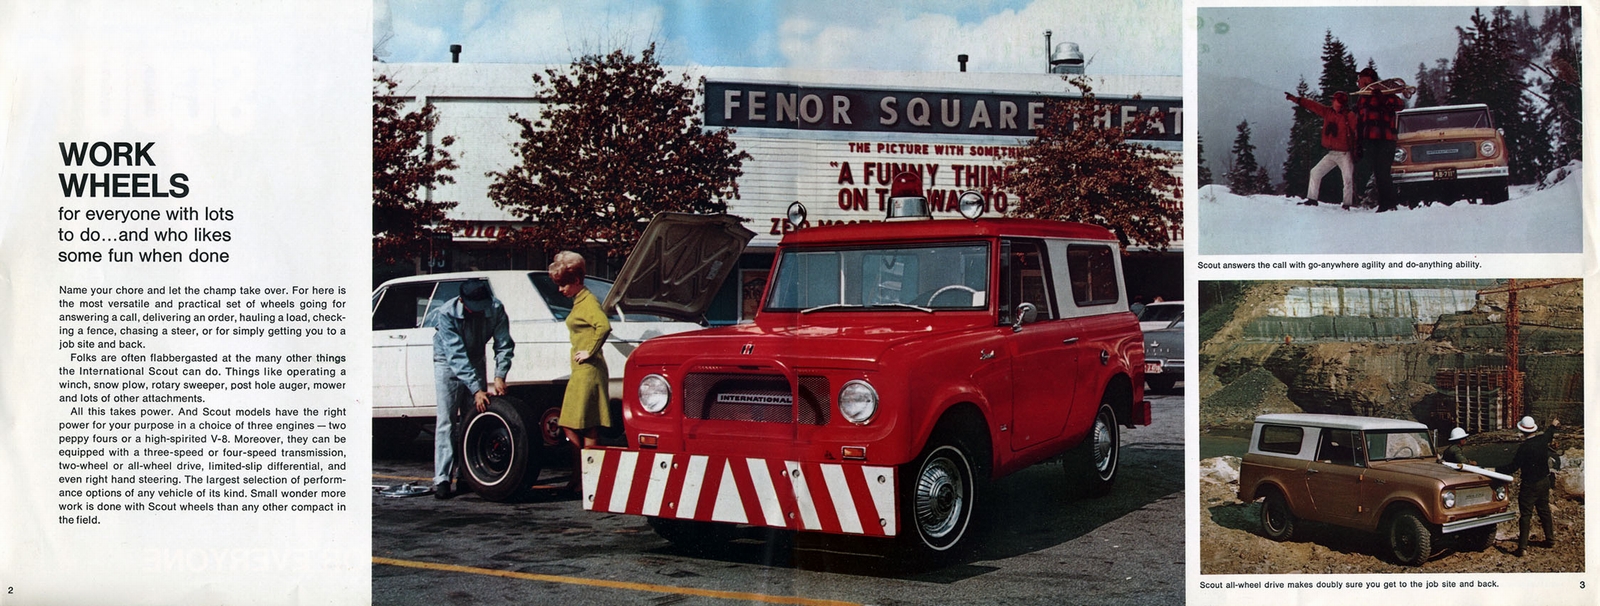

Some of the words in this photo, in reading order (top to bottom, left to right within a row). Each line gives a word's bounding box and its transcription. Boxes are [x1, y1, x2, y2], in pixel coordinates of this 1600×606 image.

[724, 90, 852, 125] FENOR
[879, 96, 1045, 130] SQUARE
[59, 141, 156, 167] WORK
[849, 142, 871, 154] THE
[877, 143, 929, 155] PICTURE
[934, 145, 964, 156] WITH
[58, 173, 189, 198] WHEELS
[838, 188, 868, 211] ON
[981, 190, 1007, 213] TO
[58, 206, 80, 220] for
[86, 210, 160, 223] everyone
[166, 207, 198, 220] with
[205, 207, 234, 221] lots
[58, 228, 74, 241] to
[154, 228, 188, 242] who
[195, 228, 231, 242] likes
[58, 251, 102, 262] some
[108, 248, 133, 262] fun
[139, 248, 182, 262] when
[189, 248, 229, 263] done
[1308, 261, 1359, 270] go-anywhere
[1362, 261, 1385, 270] agility
[1406, 261, 1452, 269] do-anything
[1456, 261, 1481, 269] ability.
[60, 286, 87, 294] Name
[91, 288, 112, 296] your
[116, 286, 144, 294] chore
[147, 286, 165, 294] and
[169, 286, 181, 295] let
[185, 286, 200, 295] the
[204, 286, 236, 296] champ
[240, 286, 261, 295] take
[292, 286, 309, 294] For
[312, 286, 334, 294] here
[338, 286, 346, 294] is
[59, 313, 109, 323] answering
[120, 313, 140, 323] call,
[143, 313, 191, 324] delivering
[208, 313, 237, 323] order,
[240, 313, 275, 324] hauling
[286, 313, 310, 323] load,
[313, 313, 346, 322] check-
[59, 340, 74, 350] job
[78, 340, 95, 348] site
[98, 340, 115, 348] and
[119, 340, 145, 348] back.
[71, 353, 97, 362] Folks
[121, 353, 146, 362] often
[150, 353, 217, 364] flabbergasted
[222, 354, 231, 362] at
[236, 354, 251, 362] the
[256, 356, 282, 364] many
[286, 354, 312, 362] other
[316, 354, 346, 364] things
[59, 367, 75, 375] the
[80, 367, 144, 375] International
[149, 367, 178, 375] Scout
[205, 367, 221, 376] do.
[225, 367, 260, 378] Things
[264, 367, 282, 376] like
[287, 367, 335, 378] operating
[59, 380, 90, 390] winch,
[122, 380, 148, 391] plow,
[152, 381, 180, 391] rotary
[184, 382, 227, 391] sweeper,
[231, 381, 251, 390] post
[255, 381, 276, 389] hole
[279, 383, 310, 391] auger,
[59, 394, 77, 402] and
[81, 394, 98, 402] lots
[101, 394, 110, 402] of
[114, 394, 139, 402] other
[142, 394, 205, 402] attachments.
[720, 395, 792, 404] INTERNATIONAL
[59, 436, 89, 444] peppy
[93, 434, 117, 443] fours
[145, 434, 206, 445] high-spirited
[211, 435, 230, 443] V-8.
[235, 435, 283, 444] Moreover,
[287, 435, 308, 445] they
[334, 435, 346, 443] be
[59, 448, 104, 458] equipped
[109, 448, 129, 456] with
[144, 448, 203, 458] three-speed
[223, 448, 276, 458] four-speed
[281, 448, 346, 458] transmission,
[59, 461, 108, 470] two-wheel
[128, 462, 171, 470] all-wheel
[177, 462, 204, 471] drive,
[209, 462, 262, 472] limited-slip
[267, 462, 323, 471] differential,
[328, 462, 346, 470] and
[86, 475, 108, 485] right
[111, 475, 135, 483] hand
[139, 475, 181, 485] steering.
[184, 475, 203, 484] The
[207, 475, 239, 486] largest
[243, 476, 287, 484] selection
[291, 475, 300, 484] of
[304, 475, 346, 486] perform-
[59, 516, 74, 524] the
[76, 515, 100, 524] field.
[8, 586, 13, 594] 2
[1316, 581, 1343, 589] doubly
[1384, 581, 1396, 589] get
[1426, 580, 1438, 589] job
[1580, 581, 1585, 589] 3
